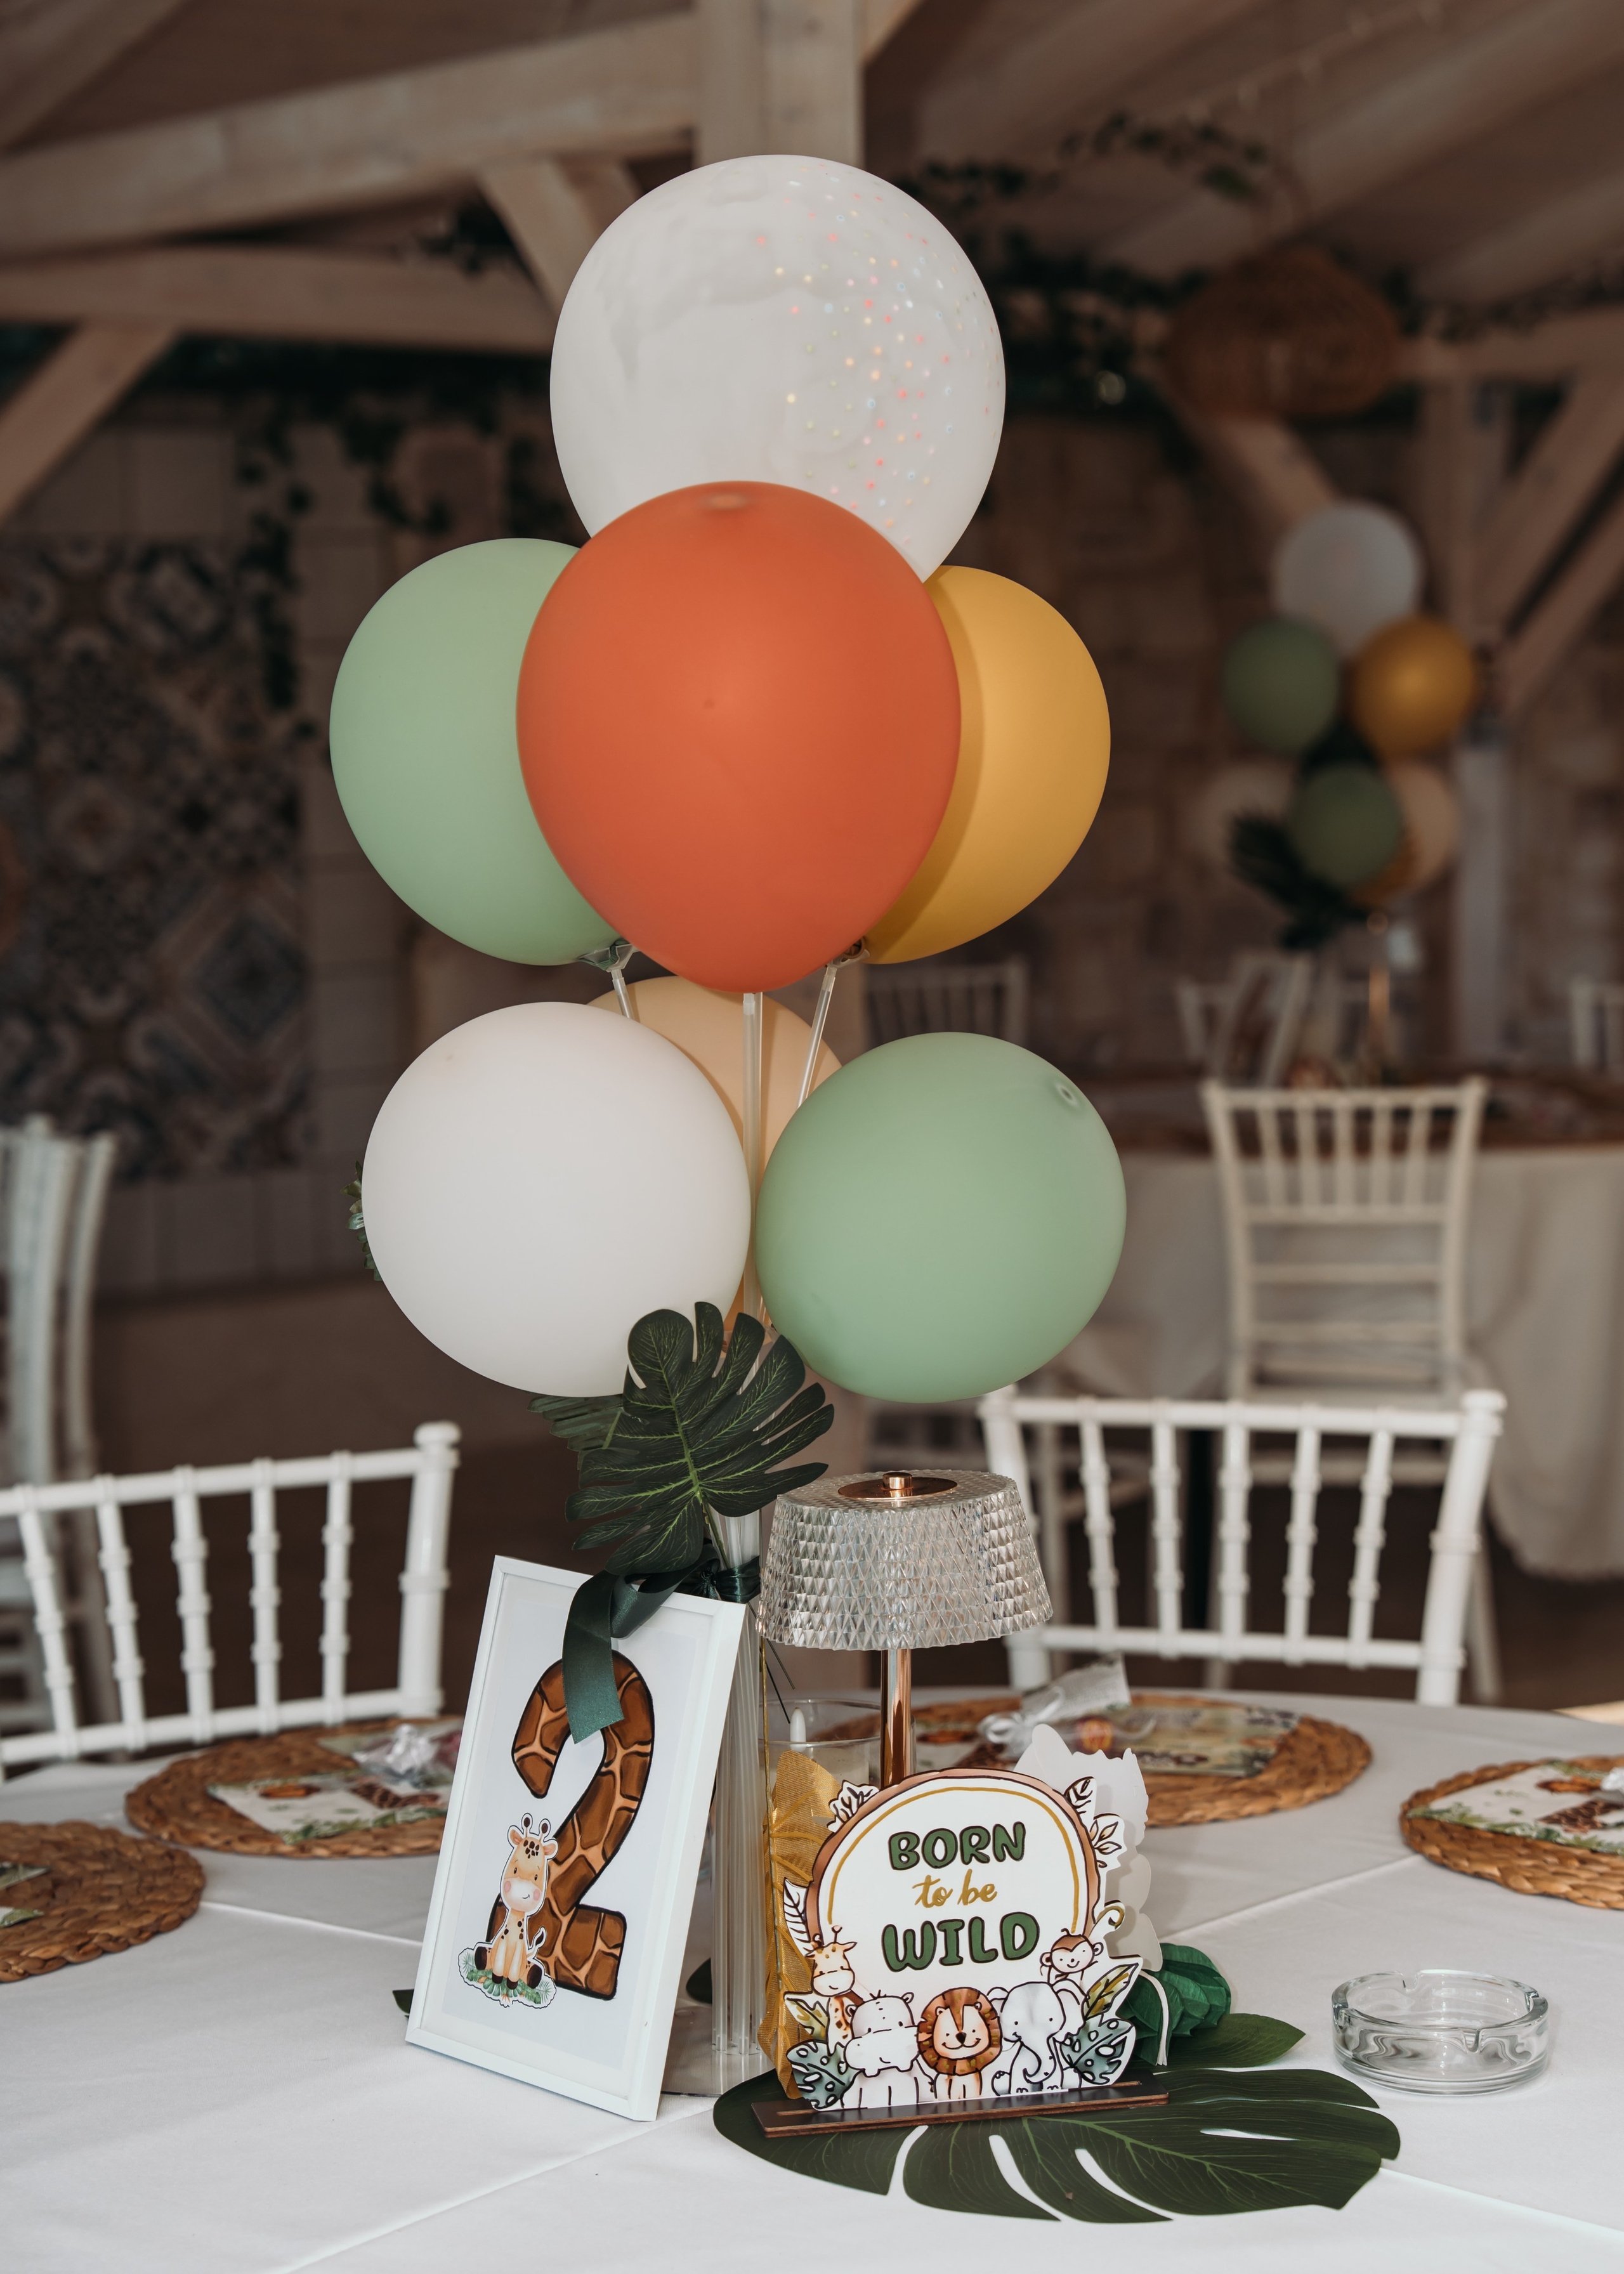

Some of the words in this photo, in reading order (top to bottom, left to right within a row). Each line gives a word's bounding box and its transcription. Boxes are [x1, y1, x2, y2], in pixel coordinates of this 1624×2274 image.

[487, 1649, 654, 2001] 2
[889, 1822, 1026, 1870] BORN
[912, 1874, 953, 1908] to
[957, 1869, 997, 1905] be
[882, 1911, 1040, 1972] WILD
